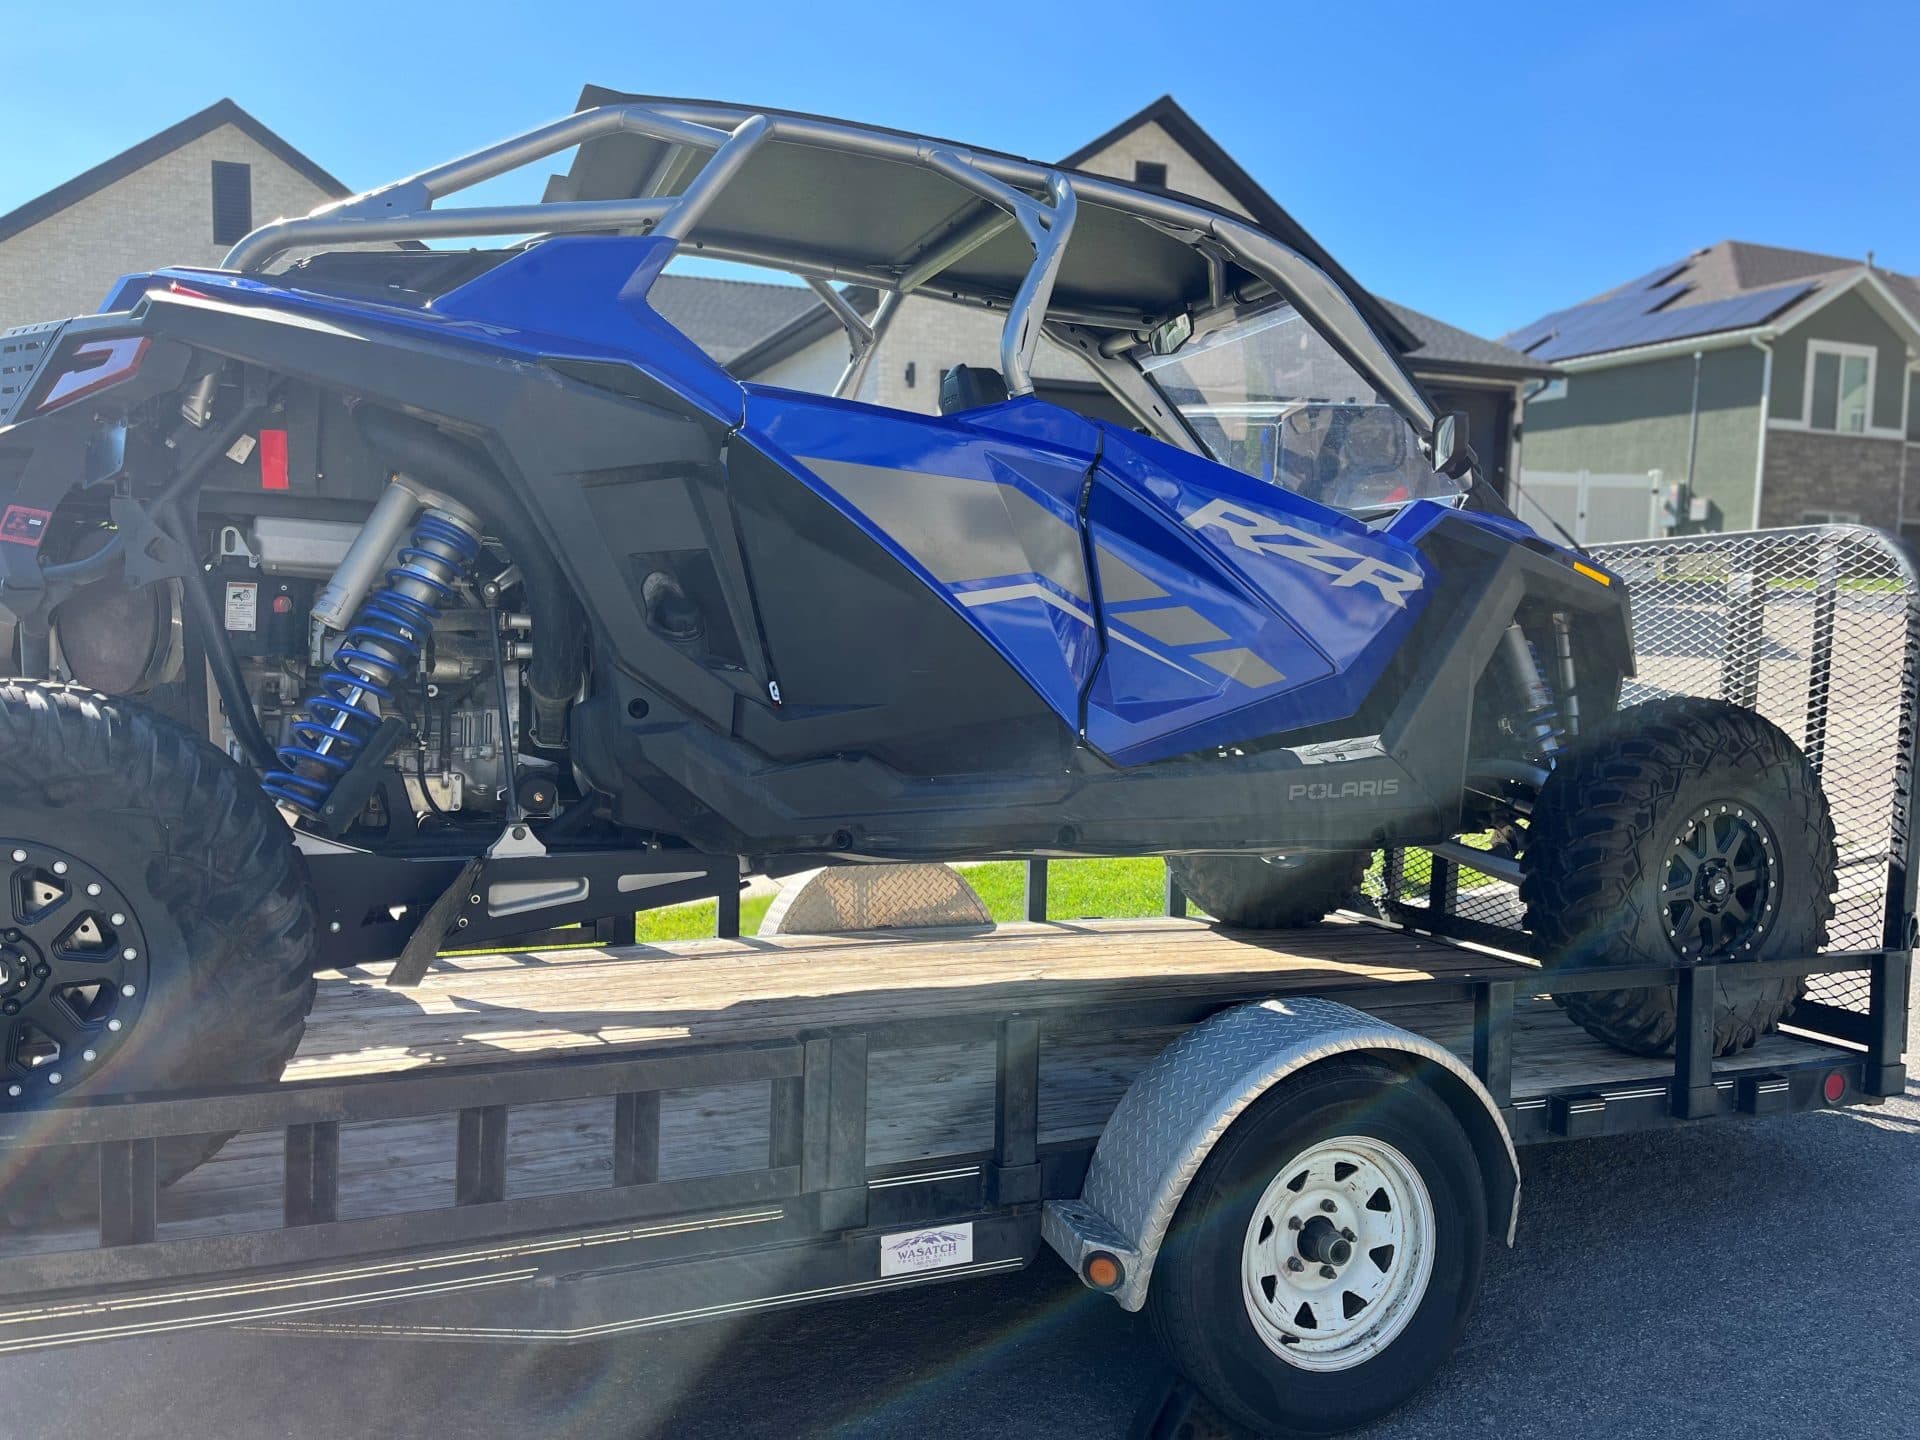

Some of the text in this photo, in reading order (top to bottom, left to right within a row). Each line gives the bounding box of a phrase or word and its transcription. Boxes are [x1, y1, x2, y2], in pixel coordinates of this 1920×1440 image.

[1181, 498, 1424, 610] RZR
[1288, 779, 1399, 801] POLARIS
[897, 1243, 957, 1260] WASATCH
